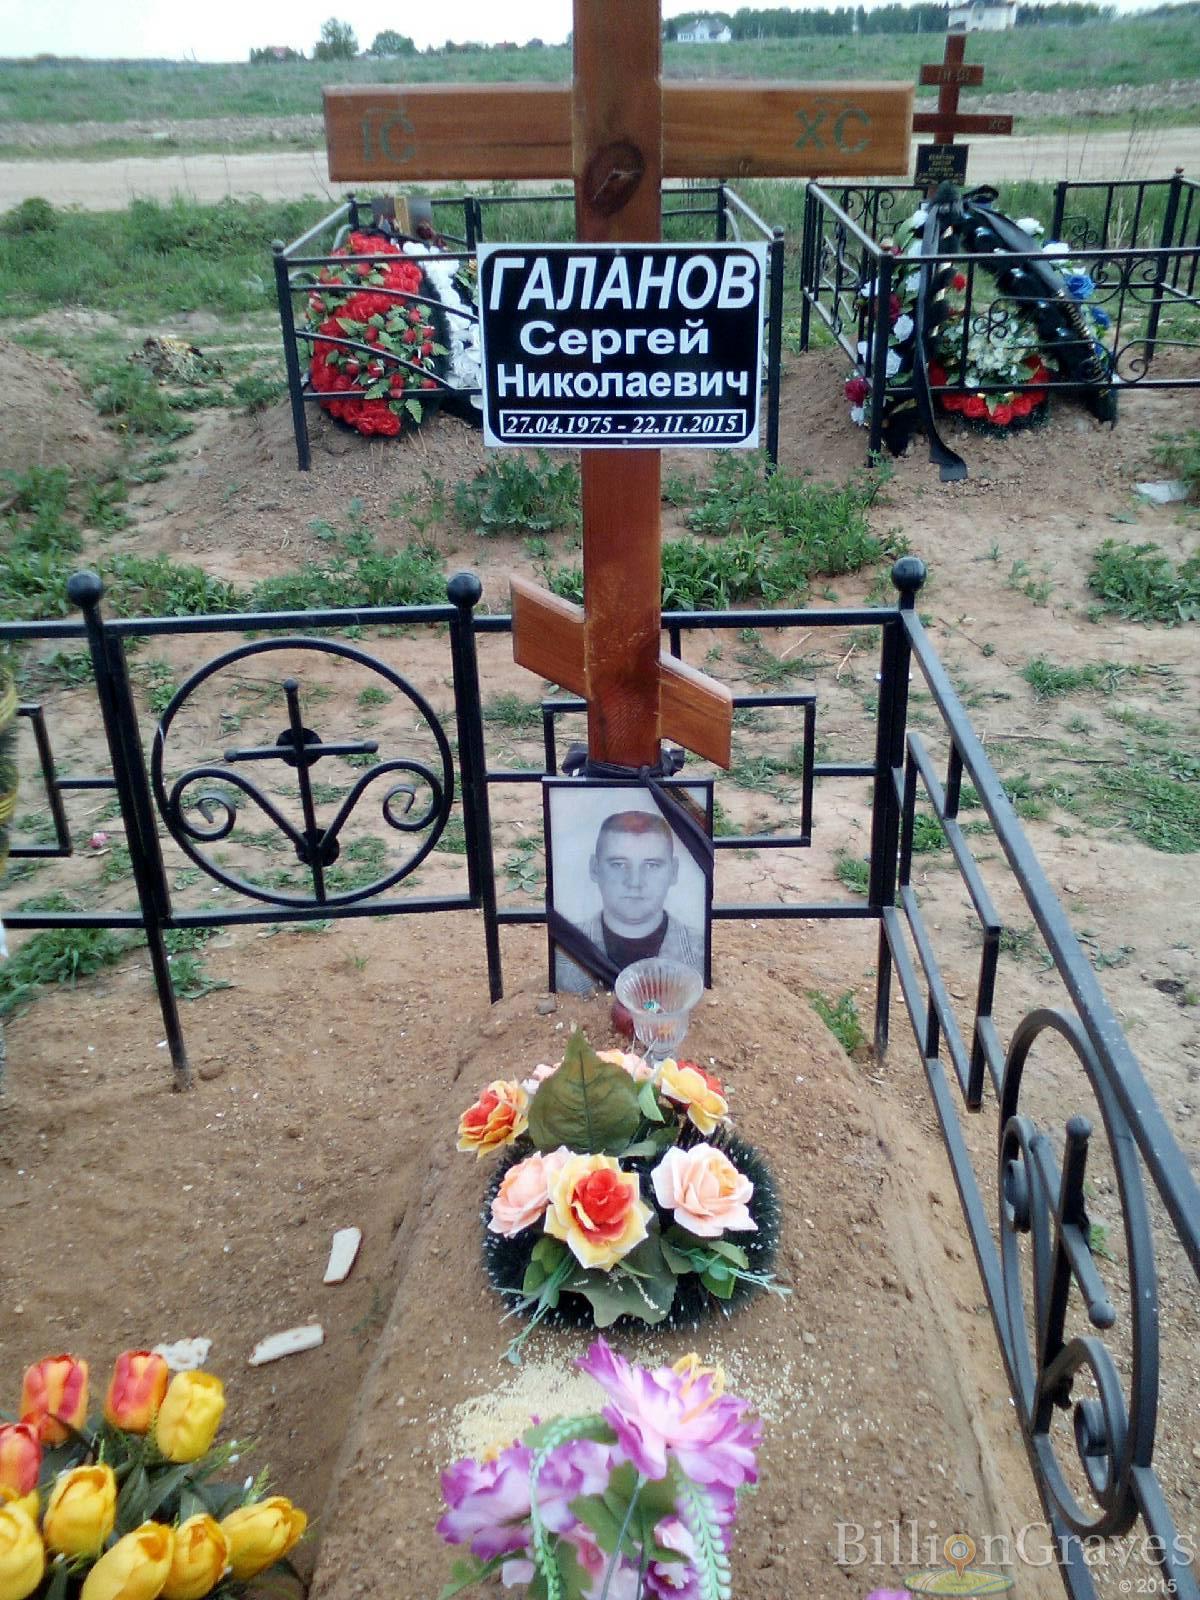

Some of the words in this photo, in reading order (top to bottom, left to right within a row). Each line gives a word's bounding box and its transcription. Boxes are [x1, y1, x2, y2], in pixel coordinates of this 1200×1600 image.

[489, 255, 757, 311] ГАЛАНОВ
[519, 318, 710, 364] Сергей
[497, 363, 748, 397] Николаевич
[506, 416, 612, 434] 27.04.1975
[631, 415, 739, 433] 22.11.2015
